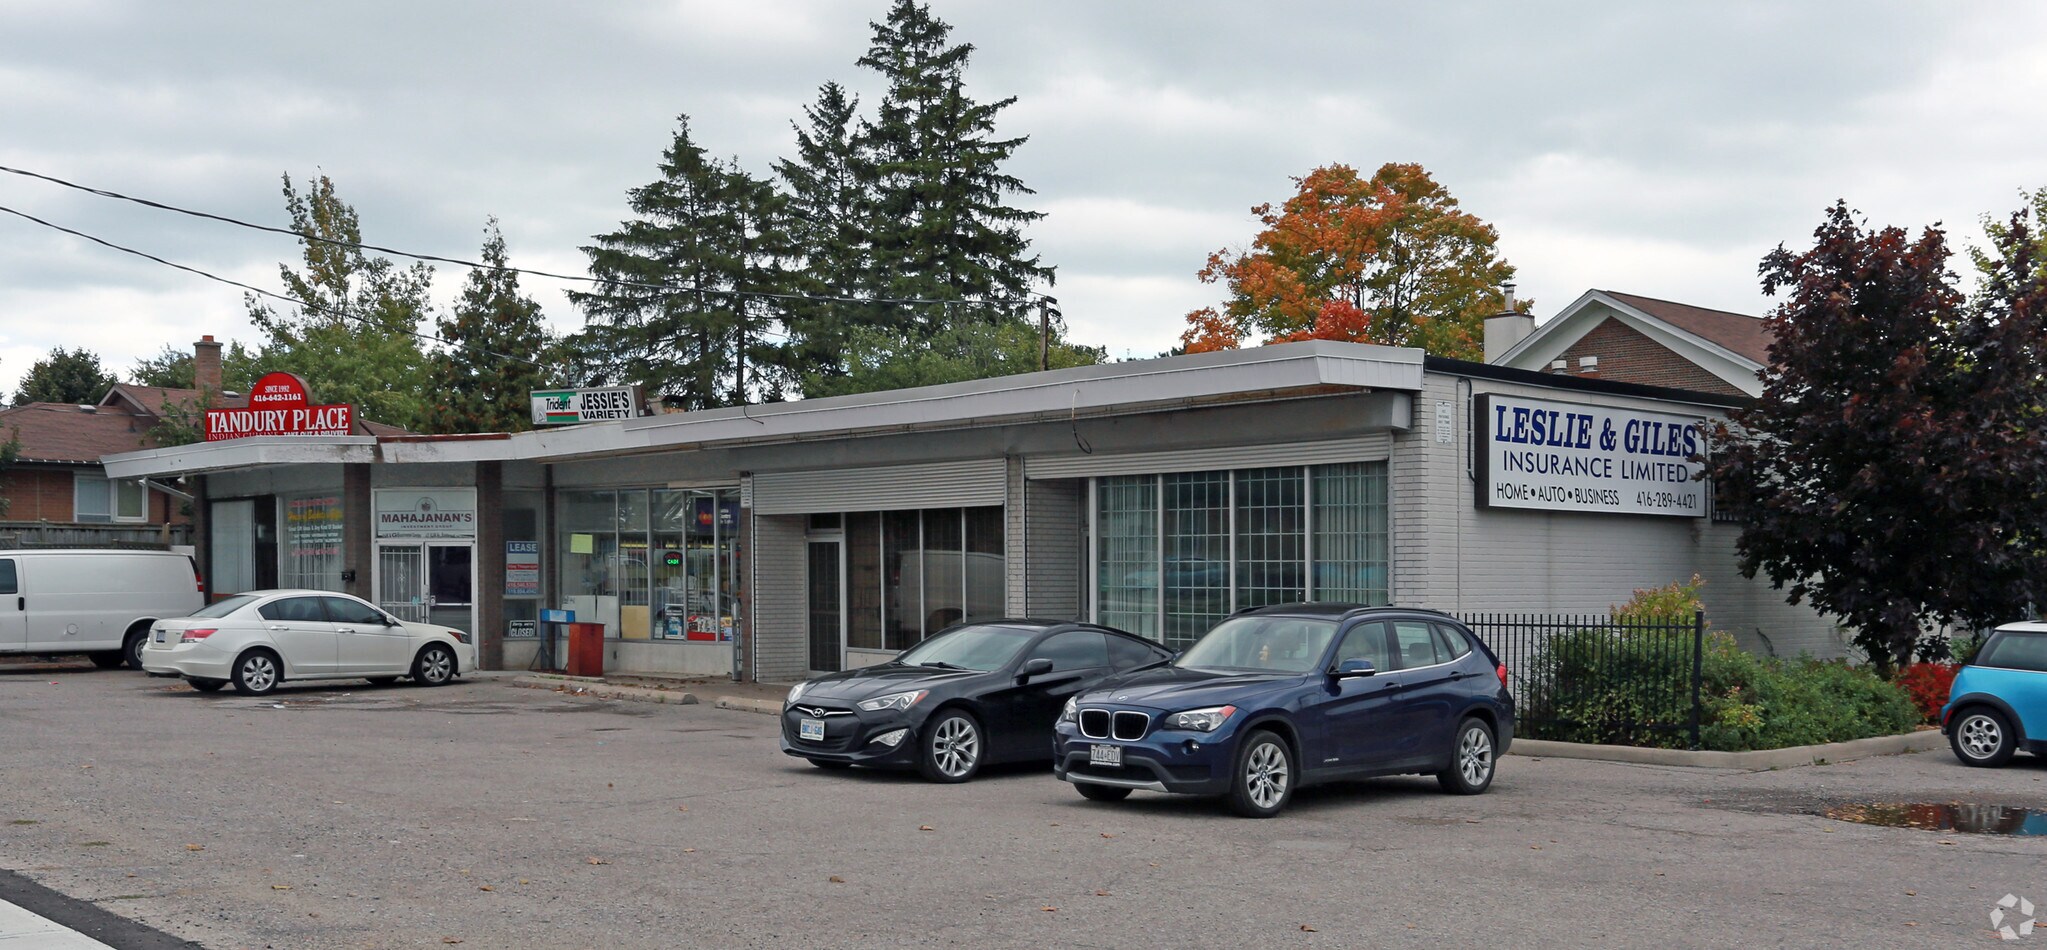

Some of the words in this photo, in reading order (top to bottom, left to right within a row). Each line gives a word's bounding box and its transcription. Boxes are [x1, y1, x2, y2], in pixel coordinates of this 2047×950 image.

[253, 393, 302, 402] 416-642-1161
[580, 391, 630, 410] JESSIE'S
[545, 398, 571, 410] Trident
[581, 409, 630, 419] VARIETY
[208, 409, 288, 433] TANDURY
[292, 407, 349, 431] PLACE
[208, 432, 241, 440] INDIAN
[1495, 404, 1593, 450] LESLIE
[1599, 417, 1617, 452] &
[1624, 418, 1697, 458] GILES
[1503, 450, 1612, 478] INSURANCE
[1621, 459, 1688, 483] LIMITED
[1497, 482, 1529, 500] HOME
[1538, 485, 1566, 503] AUTO
[1575, 488, 1620, 505] BUSINESS
[1636, 491, 1697, 510] 416-289-4421
[381, 513, 472, 523] MAHAJANAN'S
[509, 543, 537, 552] LEASE
[511, 628, 534, 637] CLOSED
